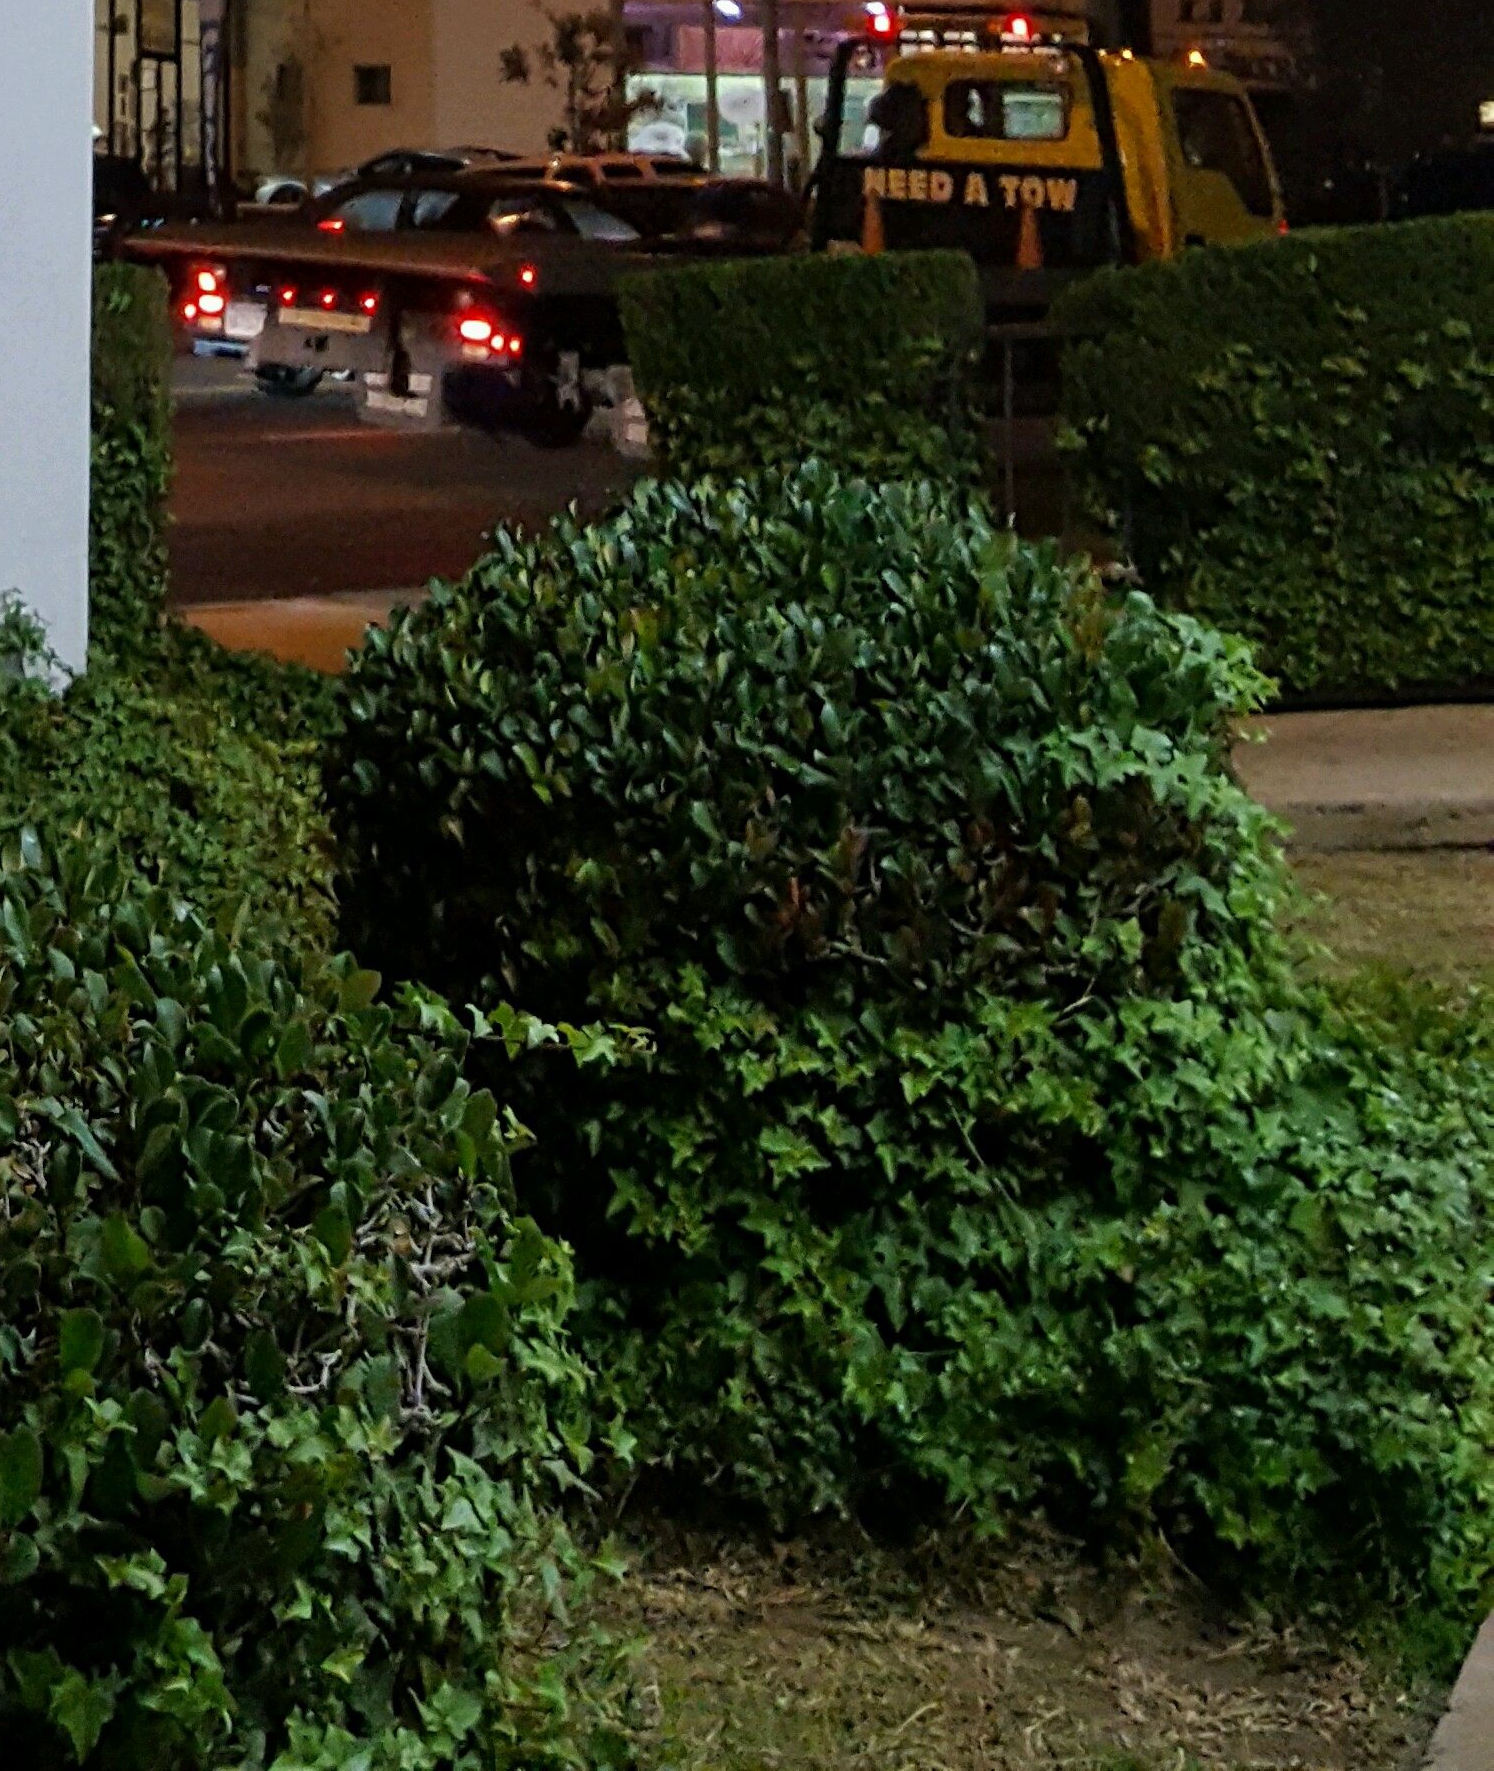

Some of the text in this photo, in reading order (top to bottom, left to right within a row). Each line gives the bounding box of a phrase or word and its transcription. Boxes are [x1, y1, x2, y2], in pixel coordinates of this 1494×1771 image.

[862, 166, 1078, 212] NEED A TOW
